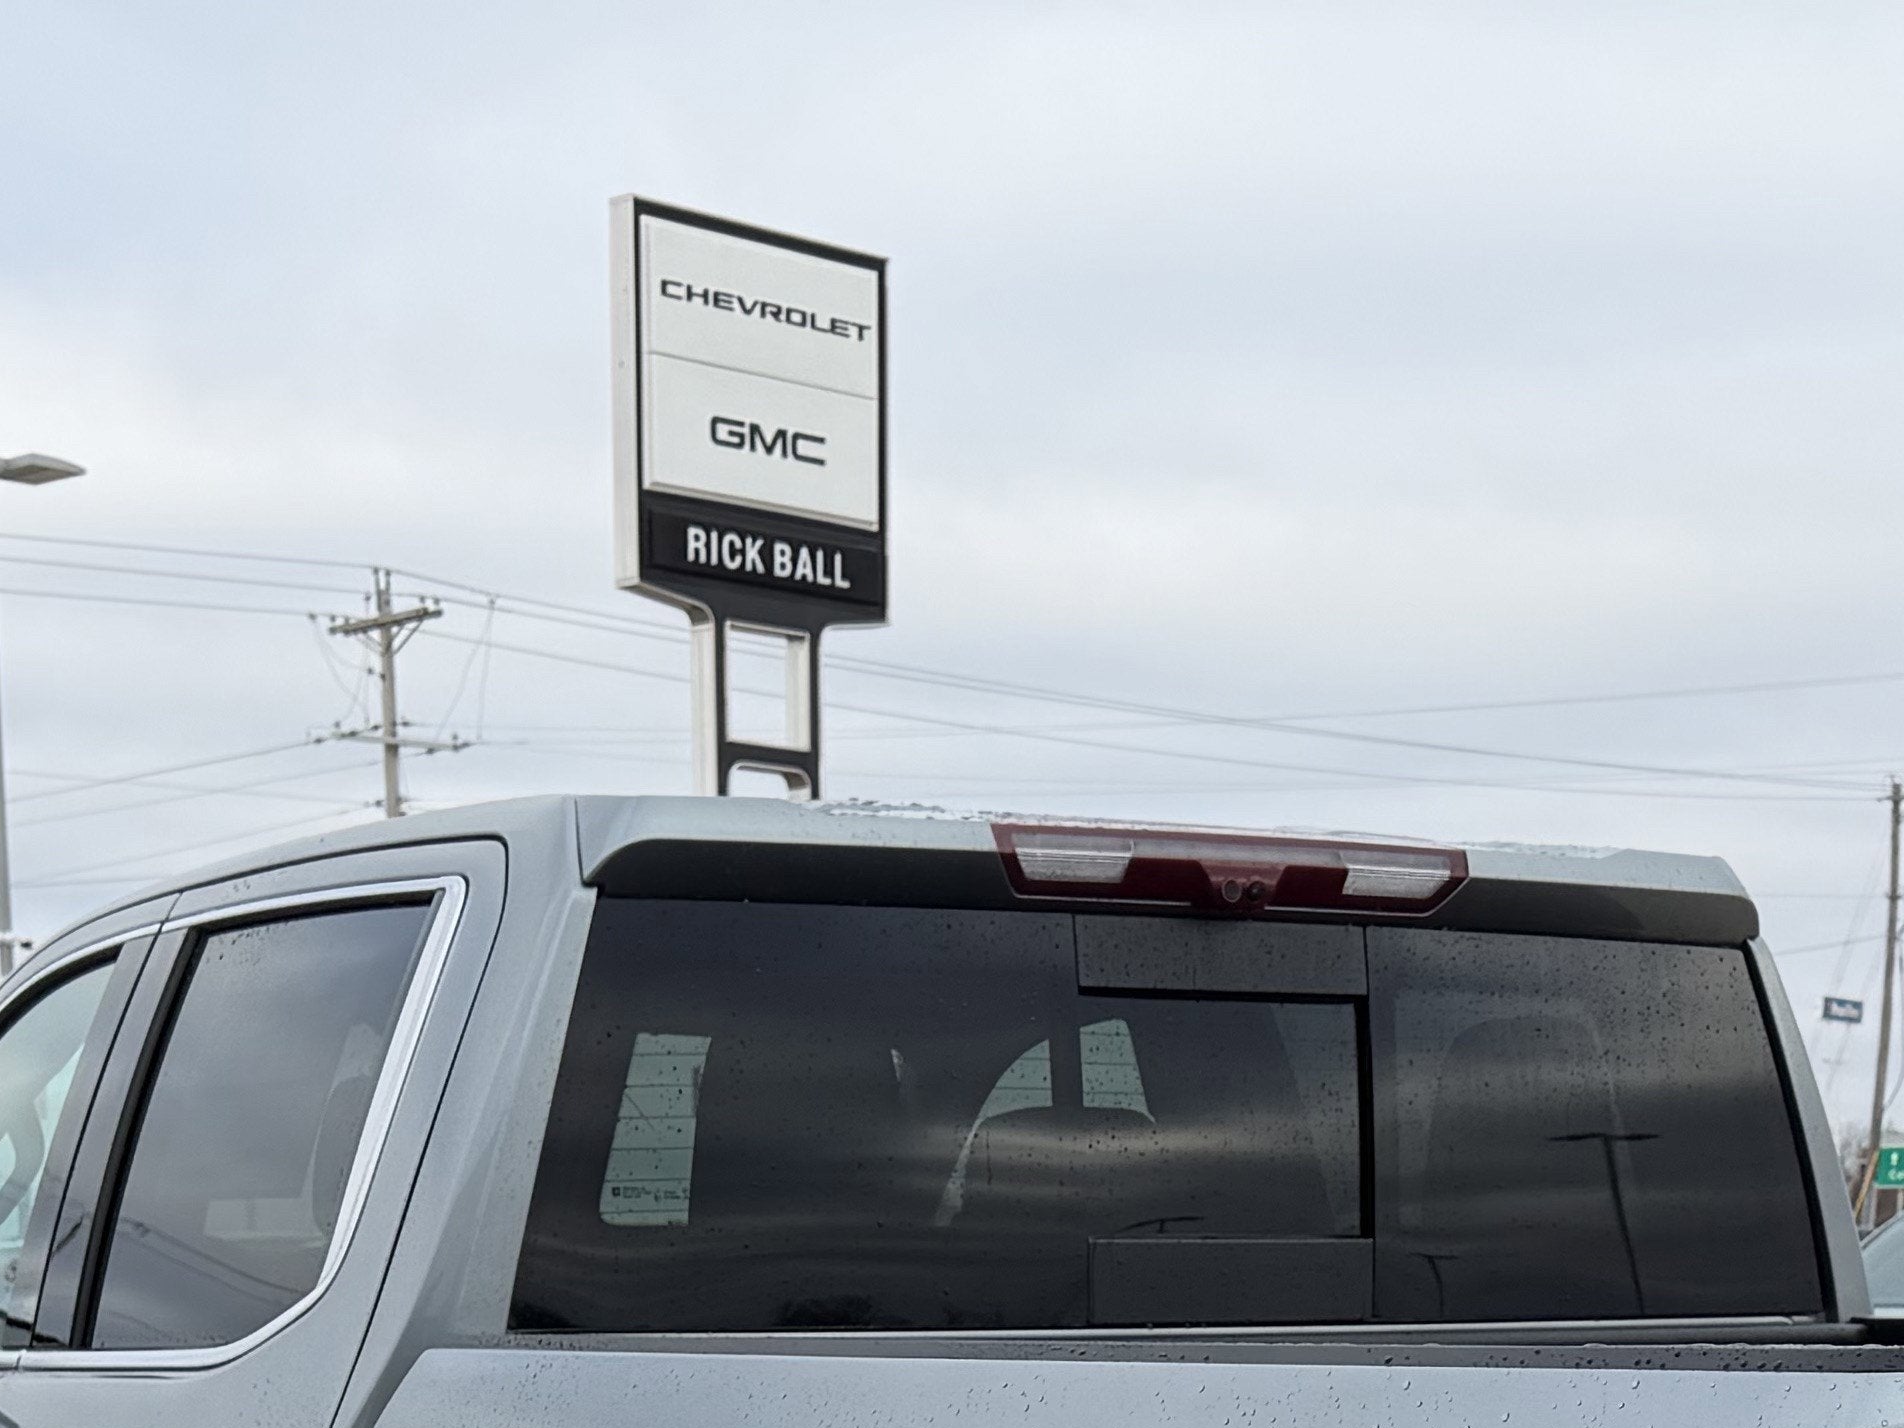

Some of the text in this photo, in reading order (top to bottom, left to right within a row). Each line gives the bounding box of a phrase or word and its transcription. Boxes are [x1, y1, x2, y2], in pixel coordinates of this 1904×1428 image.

[659, 278, 872, 342] CHEVROLET
[710, 415, 827, 466] GMC
[685, 525, 852, 590] RICK BALL
